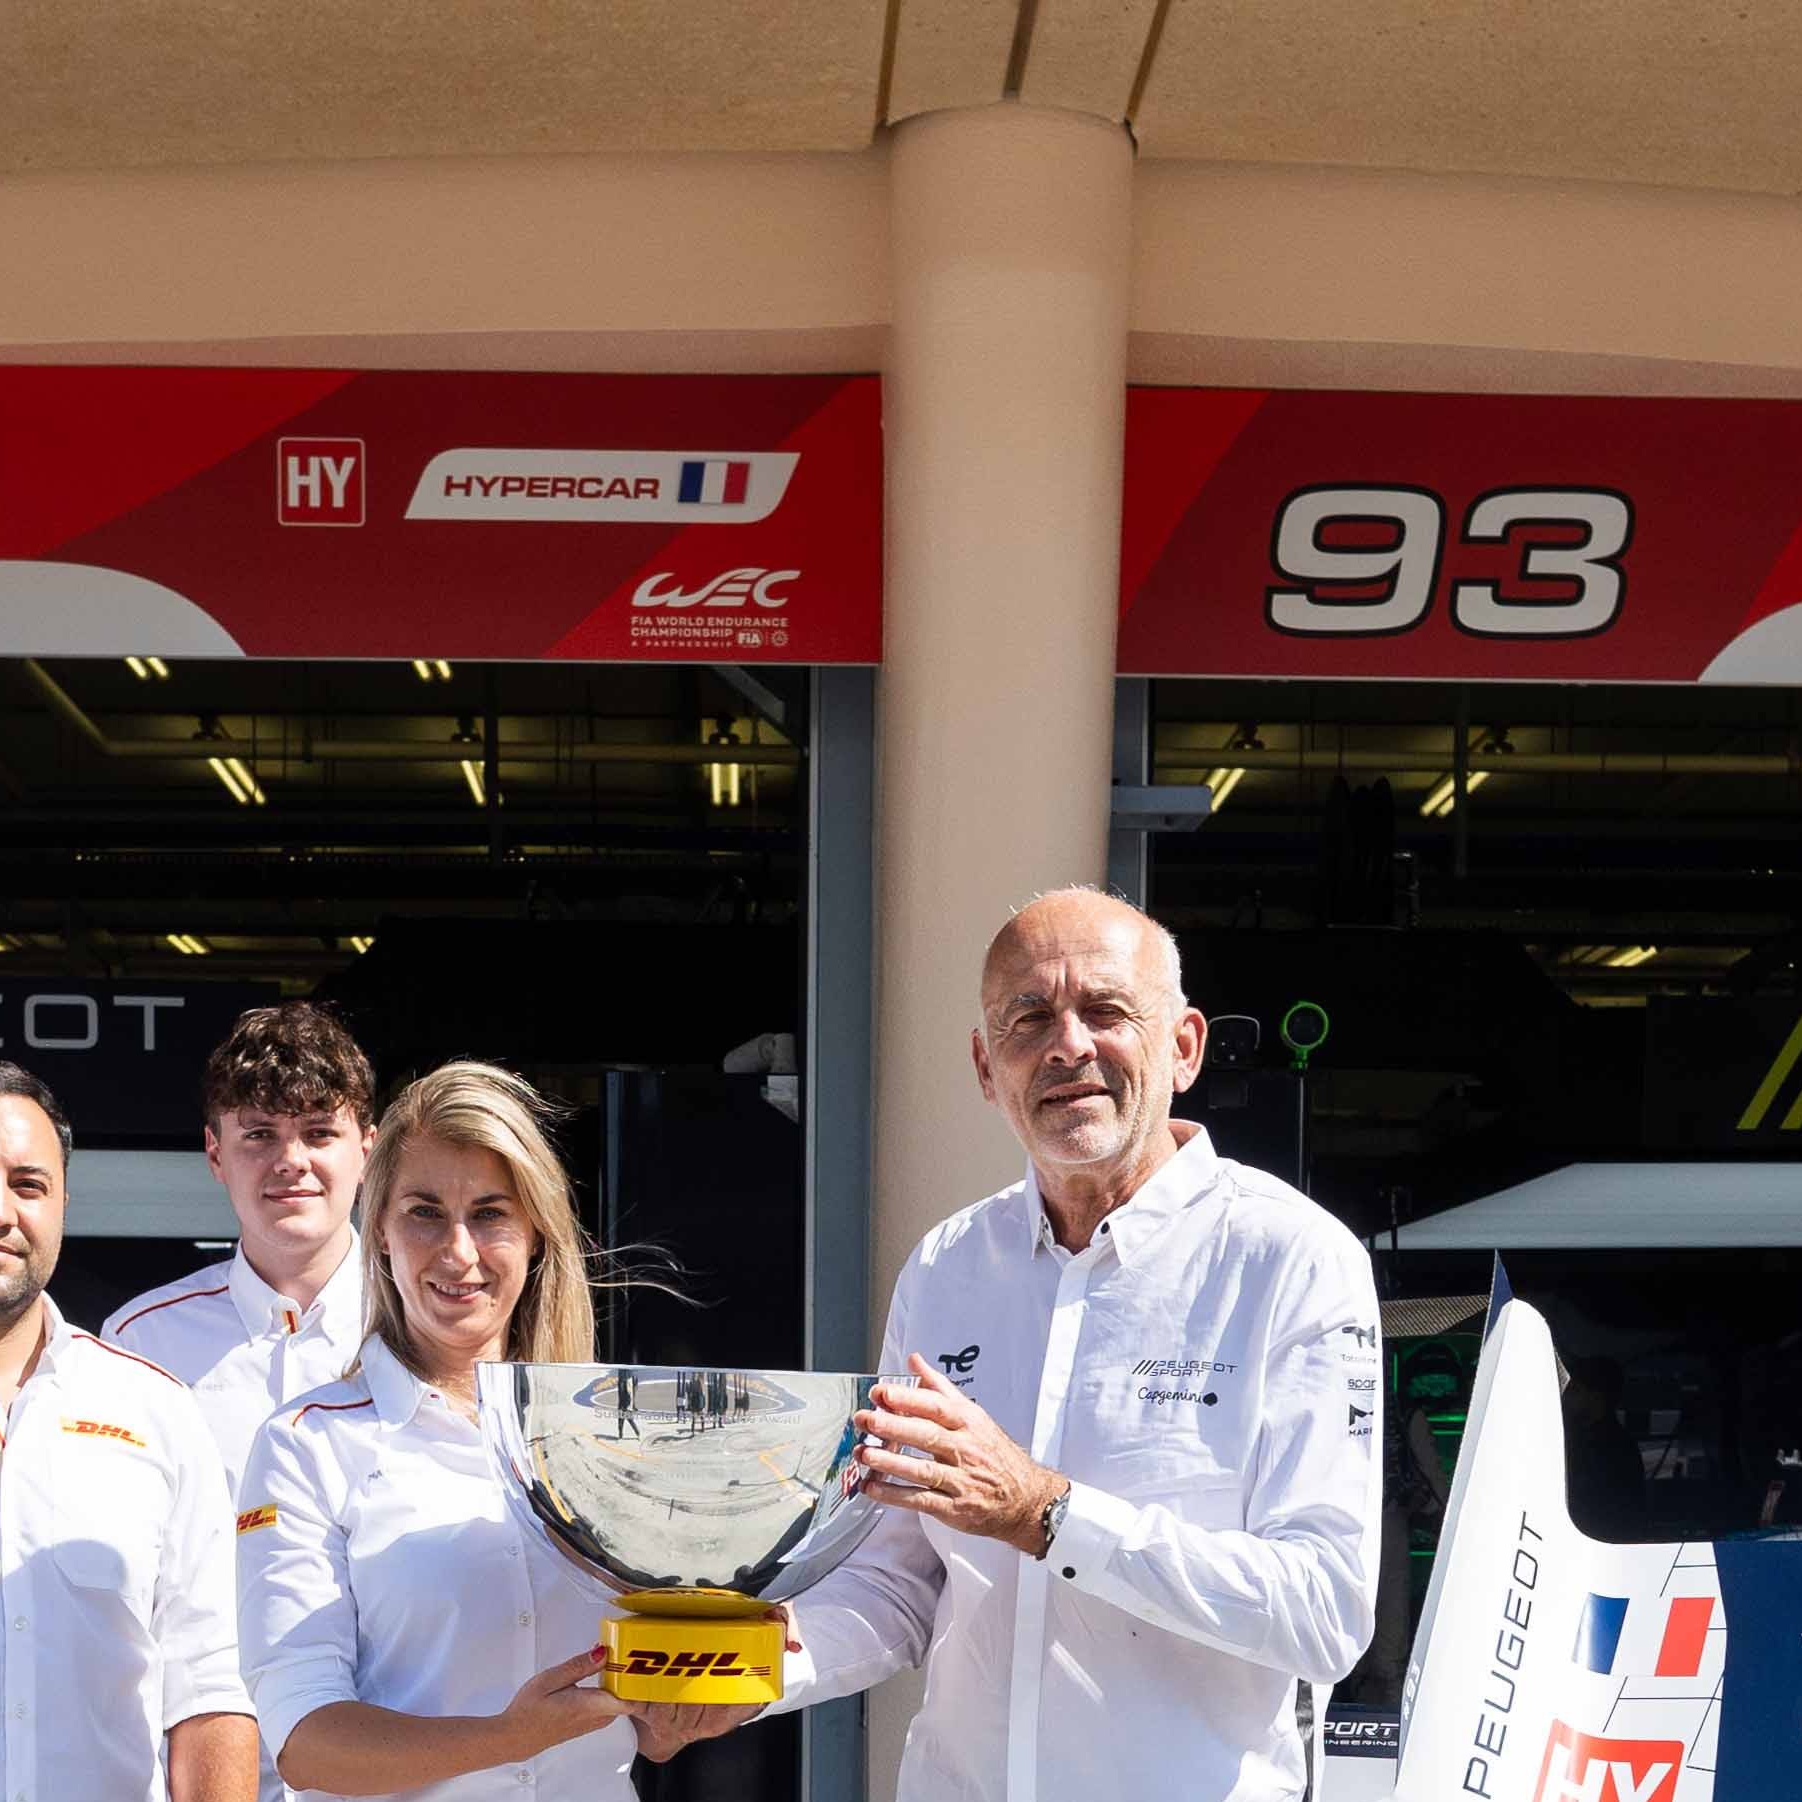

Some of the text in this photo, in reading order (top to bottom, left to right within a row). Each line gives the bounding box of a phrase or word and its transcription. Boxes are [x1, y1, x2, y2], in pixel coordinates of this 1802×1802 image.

[288, 455, 356, 509] HY
[443, 475, 660, 501] HYPERCAR
[1266, 483, 1635, 640] 93
[631, 567, 802, 608] WEC
[630, 627, 734, 638] CHAMPIONSHIP
[631, 616, 789, 628] FIA WORLD ENDURANCE
[1149, 1368, 1205, 1377] SPORT
[1156, 1359, 1239, 1374] PEUGEOT
[1137, 1386, 1203, 1406] Capgemini
[75, 1420, 138, 1444] DHL
[623, 1649, 746, 1677] DHL
[1462, 1509, 1547, 1800] PEUGEOT
